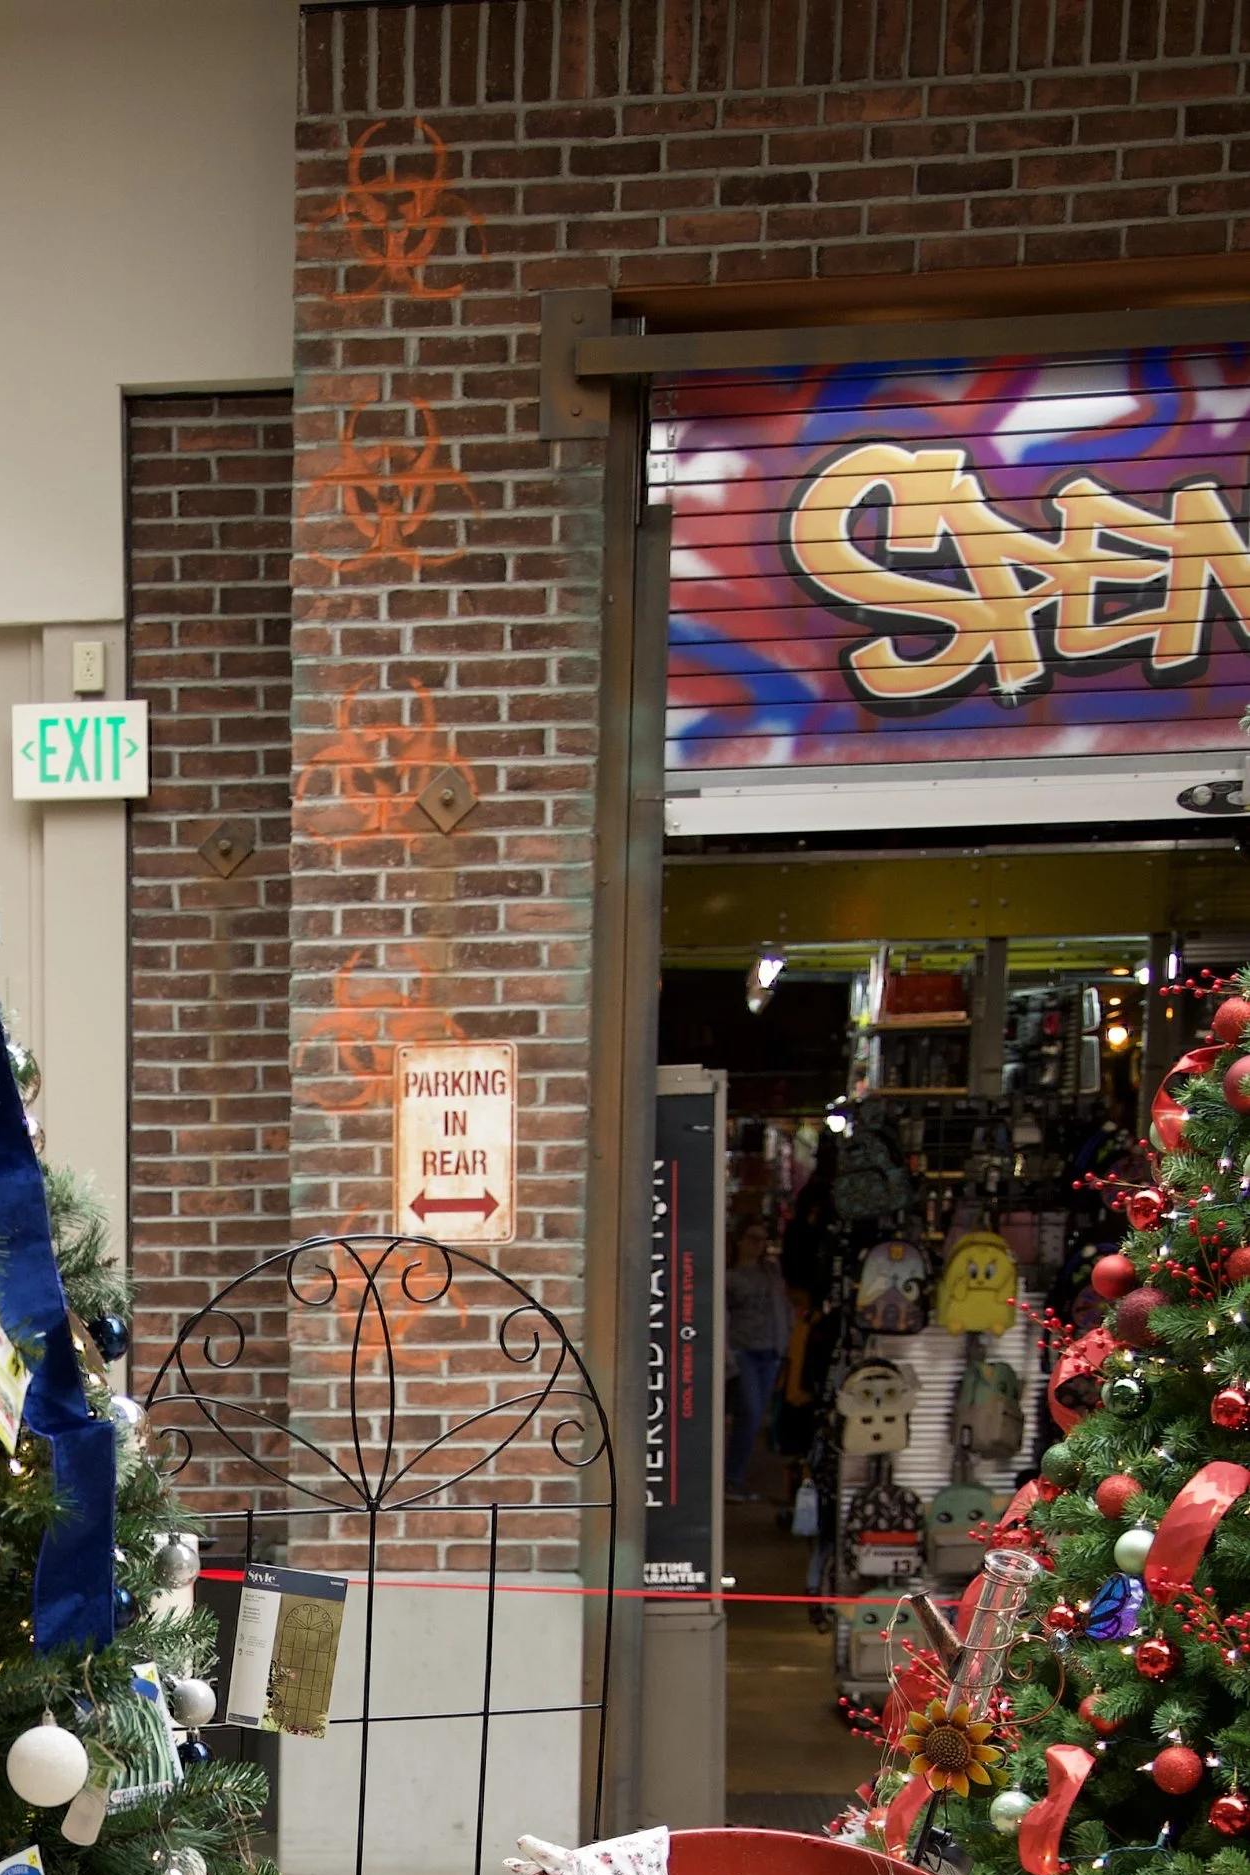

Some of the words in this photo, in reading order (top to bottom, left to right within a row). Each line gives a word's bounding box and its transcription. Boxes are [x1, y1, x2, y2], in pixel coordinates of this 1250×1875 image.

[39, 716, 126, 783] EXIT
[404, 1069, 506, 1099] PARKING
[444, 1110, 467, 1137] IN
[422, 1149, 487, 1177] REAR
[682, 1293, 694, 1323] FREE
[248, 1569, 277, 1584] Style
